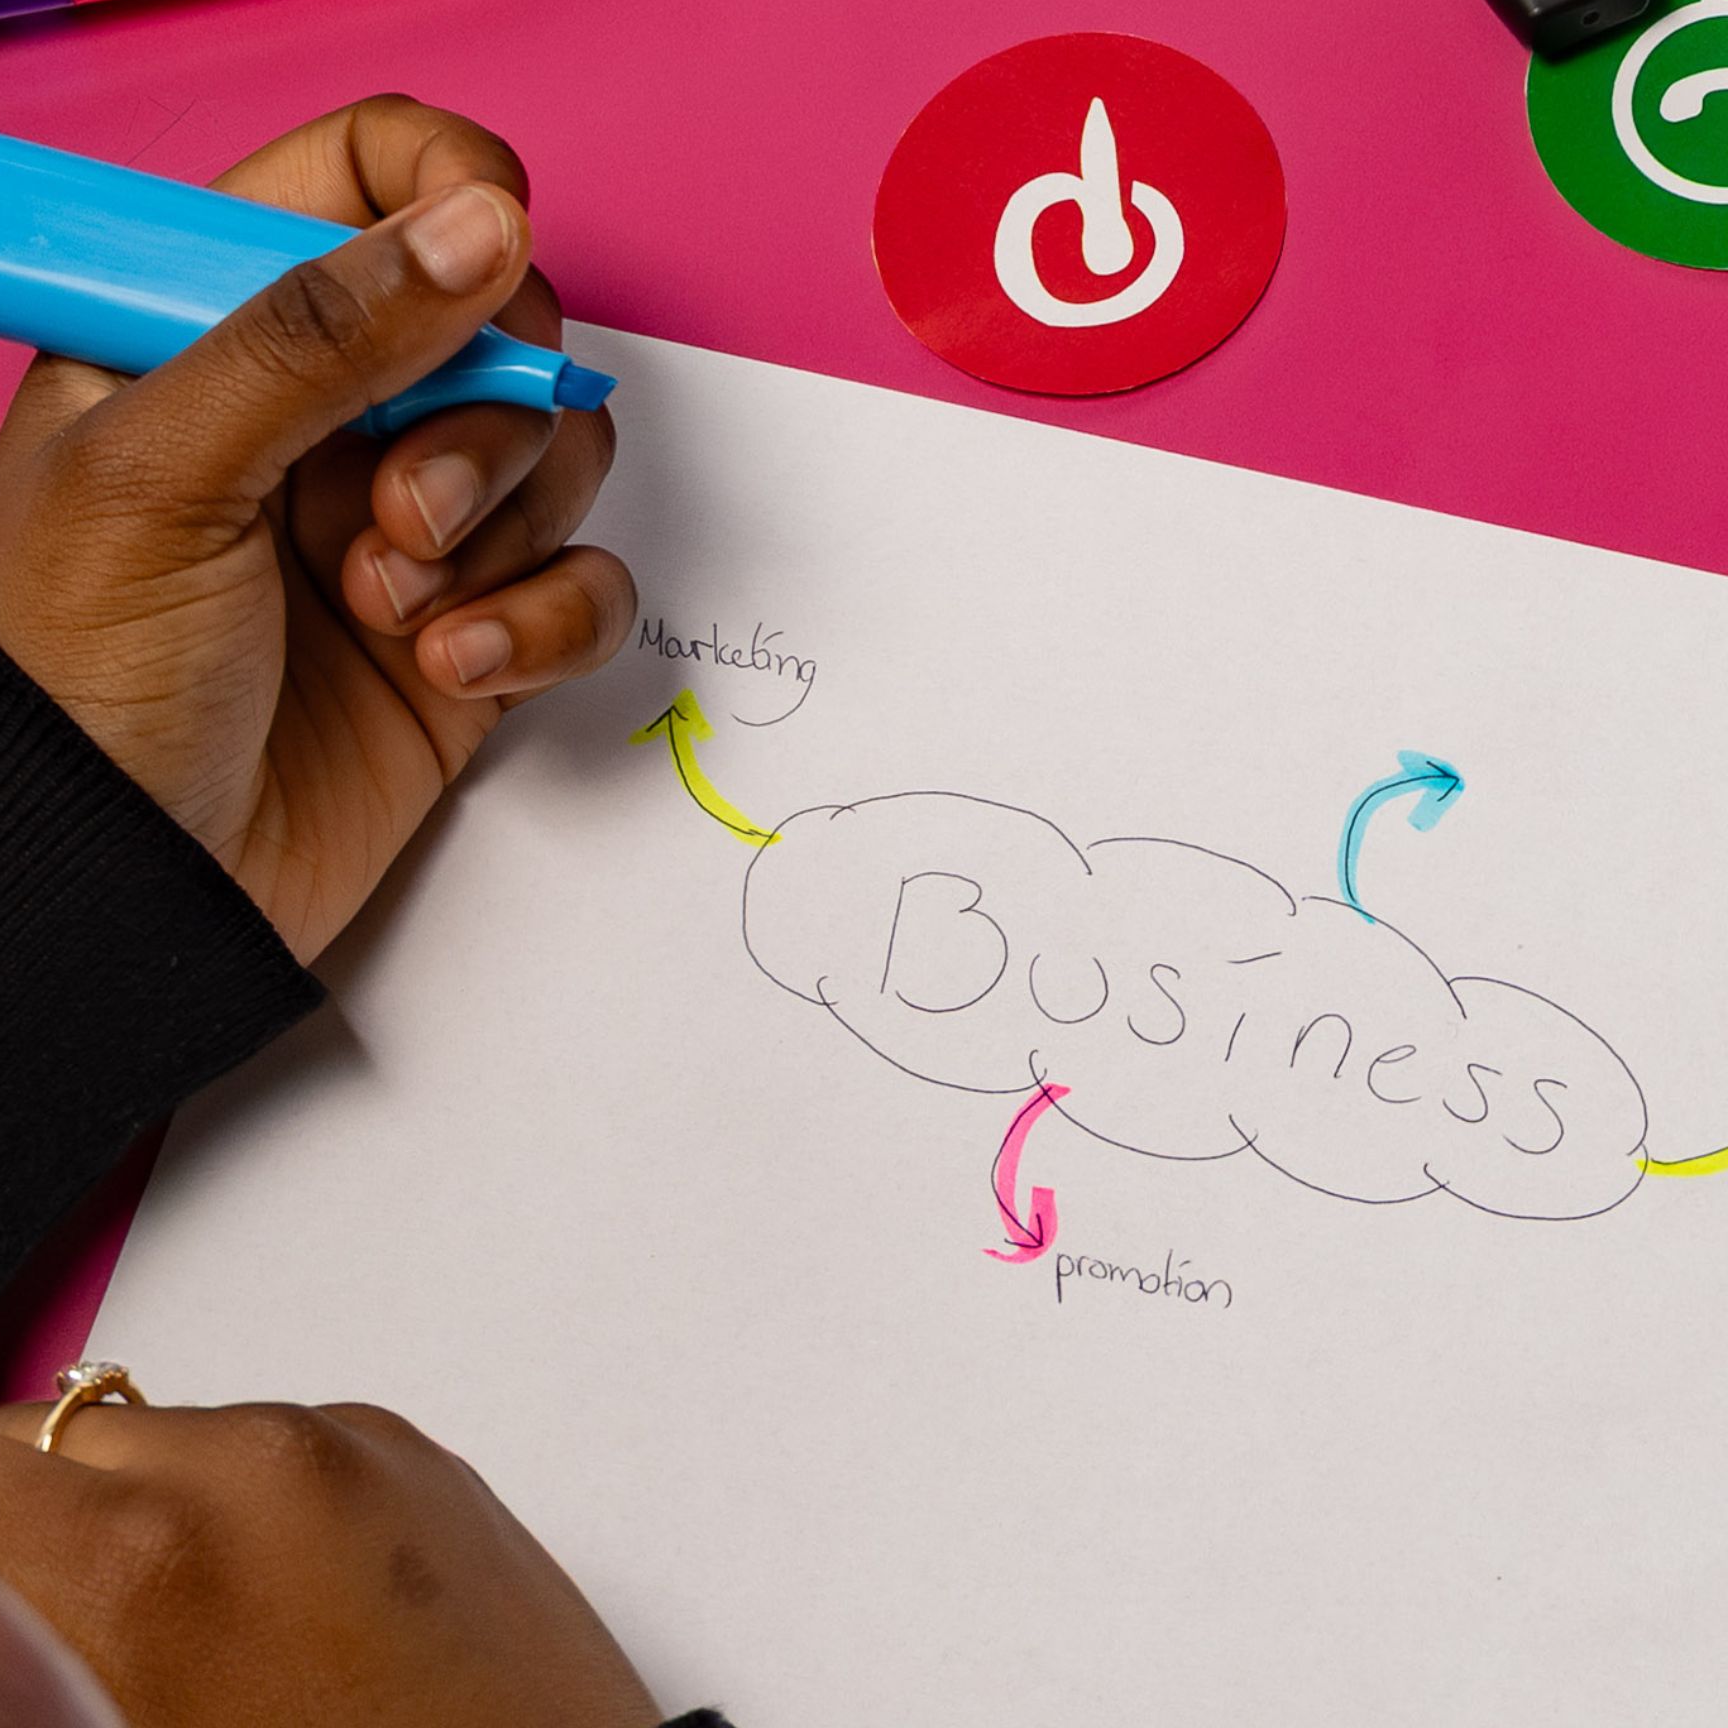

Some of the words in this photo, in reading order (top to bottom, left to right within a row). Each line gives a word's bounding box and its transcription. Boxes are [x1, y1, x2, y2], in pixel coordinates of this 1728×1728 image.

[639, 618, 817, 728] Marketing
[881, 872, 1570, 1154] Business
[1055, 1248, 1233, 1309] promotion
